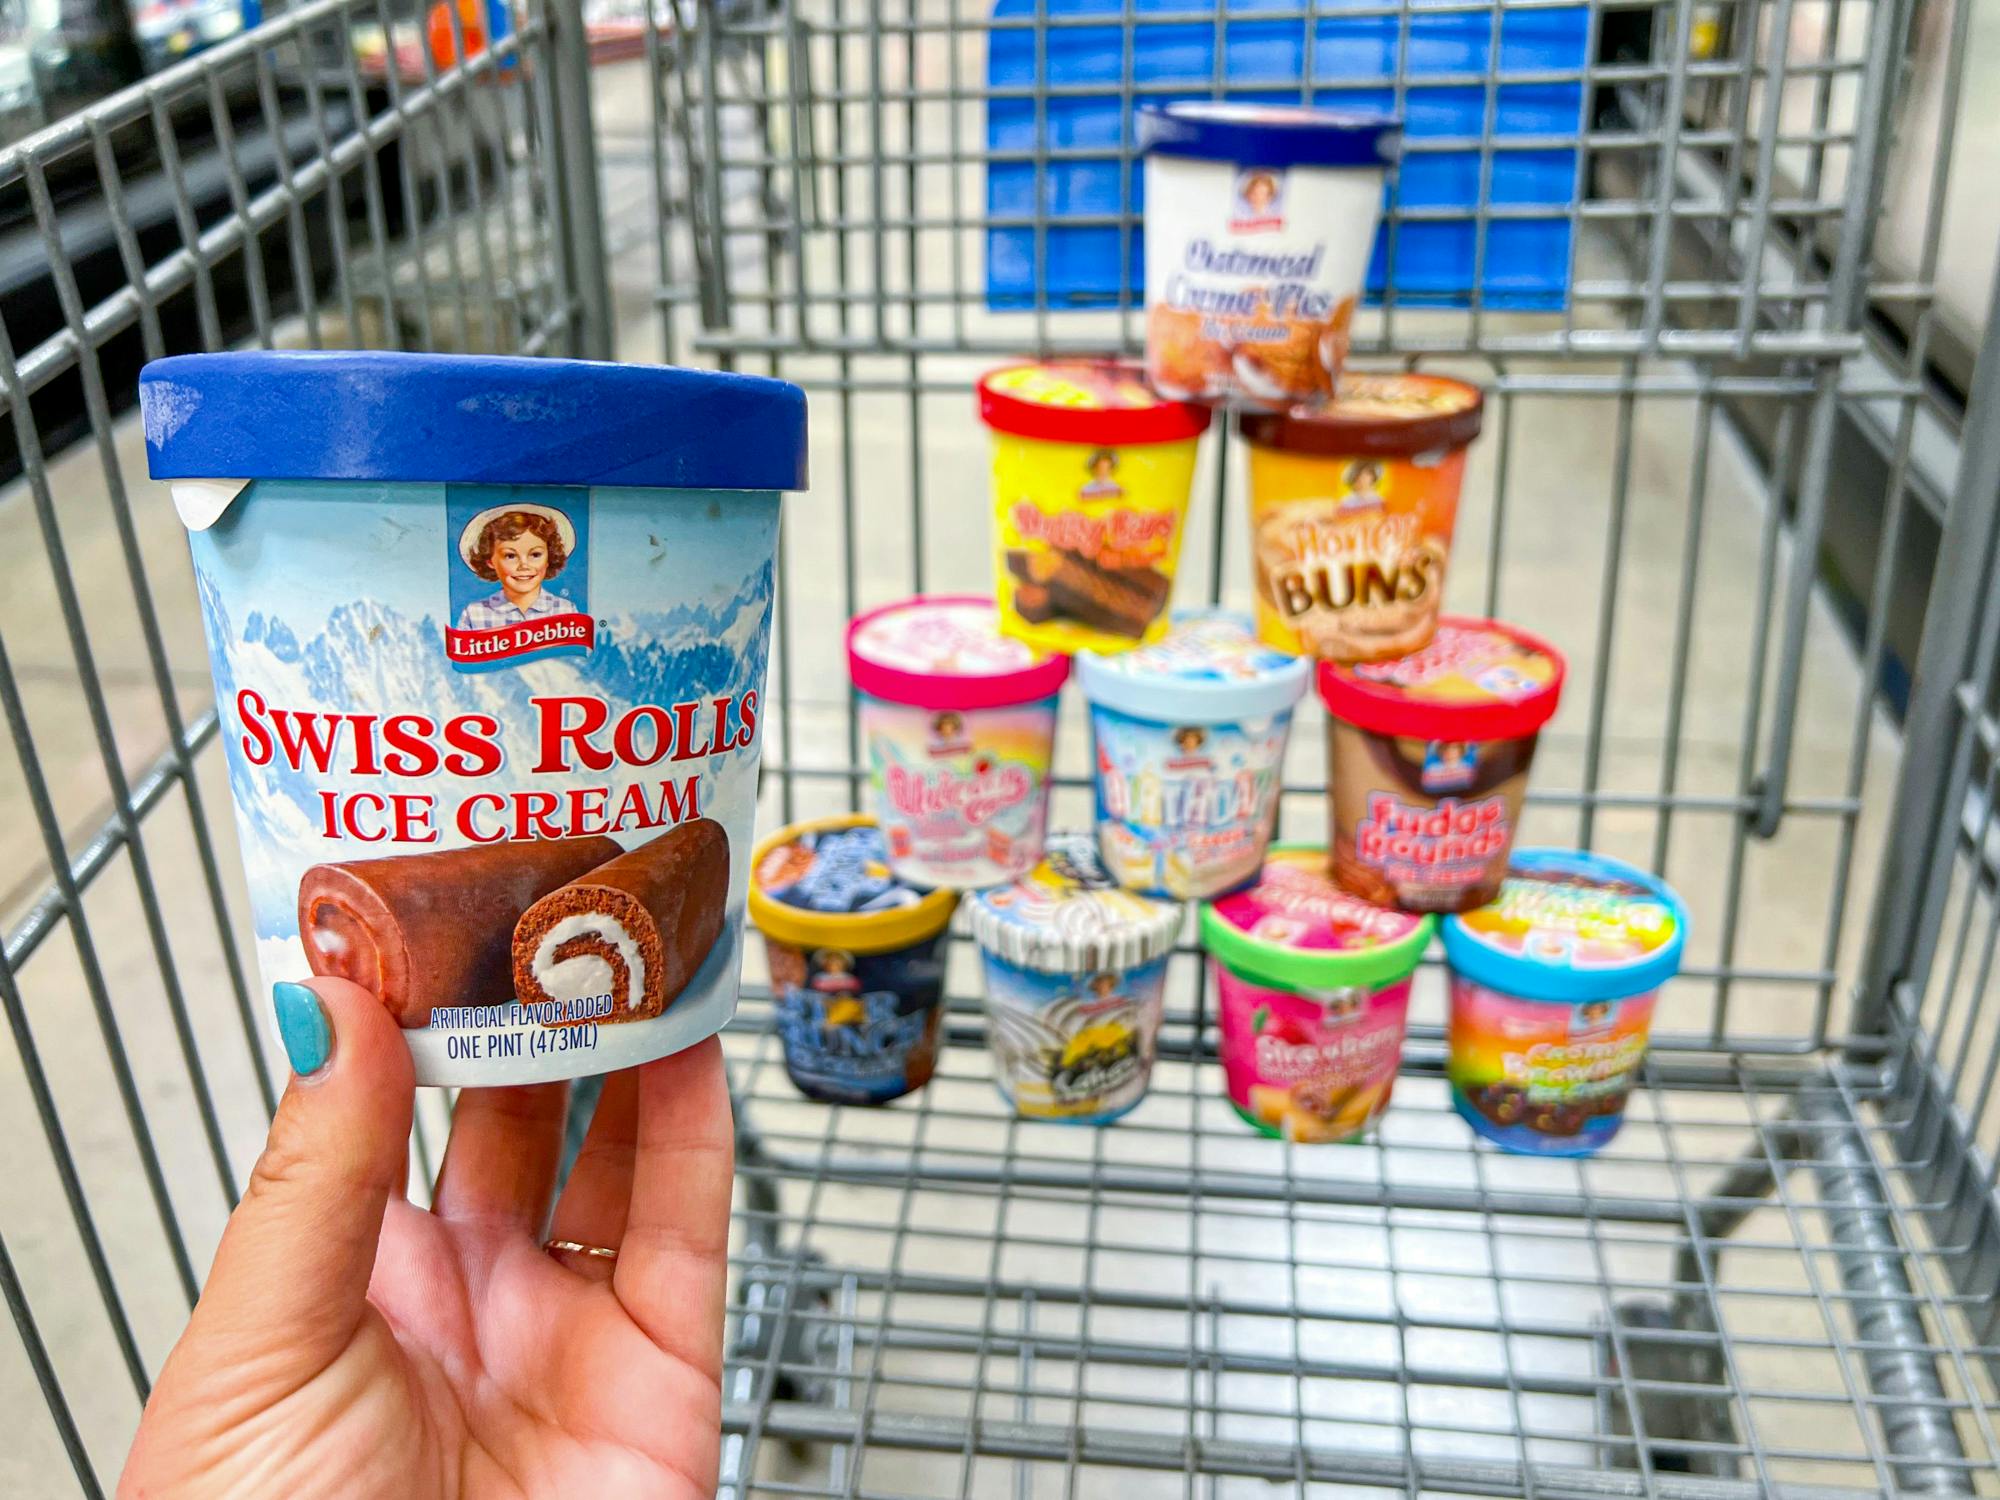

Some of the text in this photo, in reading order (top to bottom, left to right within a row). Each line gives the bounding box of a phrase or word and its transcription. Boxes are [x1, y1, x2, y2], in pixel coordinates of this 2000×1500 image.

[1277, 551, 1434, 617] BUNS
[453, 621, 587, 656] Little Debbie
[237, 688, 759, 777] SWISS ROLLS
[318, 774, 702, 843] ICE CREAM
[1371, 795, 1503, 838] Fudge
[1360, 827, 1507, 868] Rounds
[431, 994, 613, 1030] ARTIFICIAL FLAVOR ADDED
[447, 1022, 599, 1060] ONE PINT (473ML)
